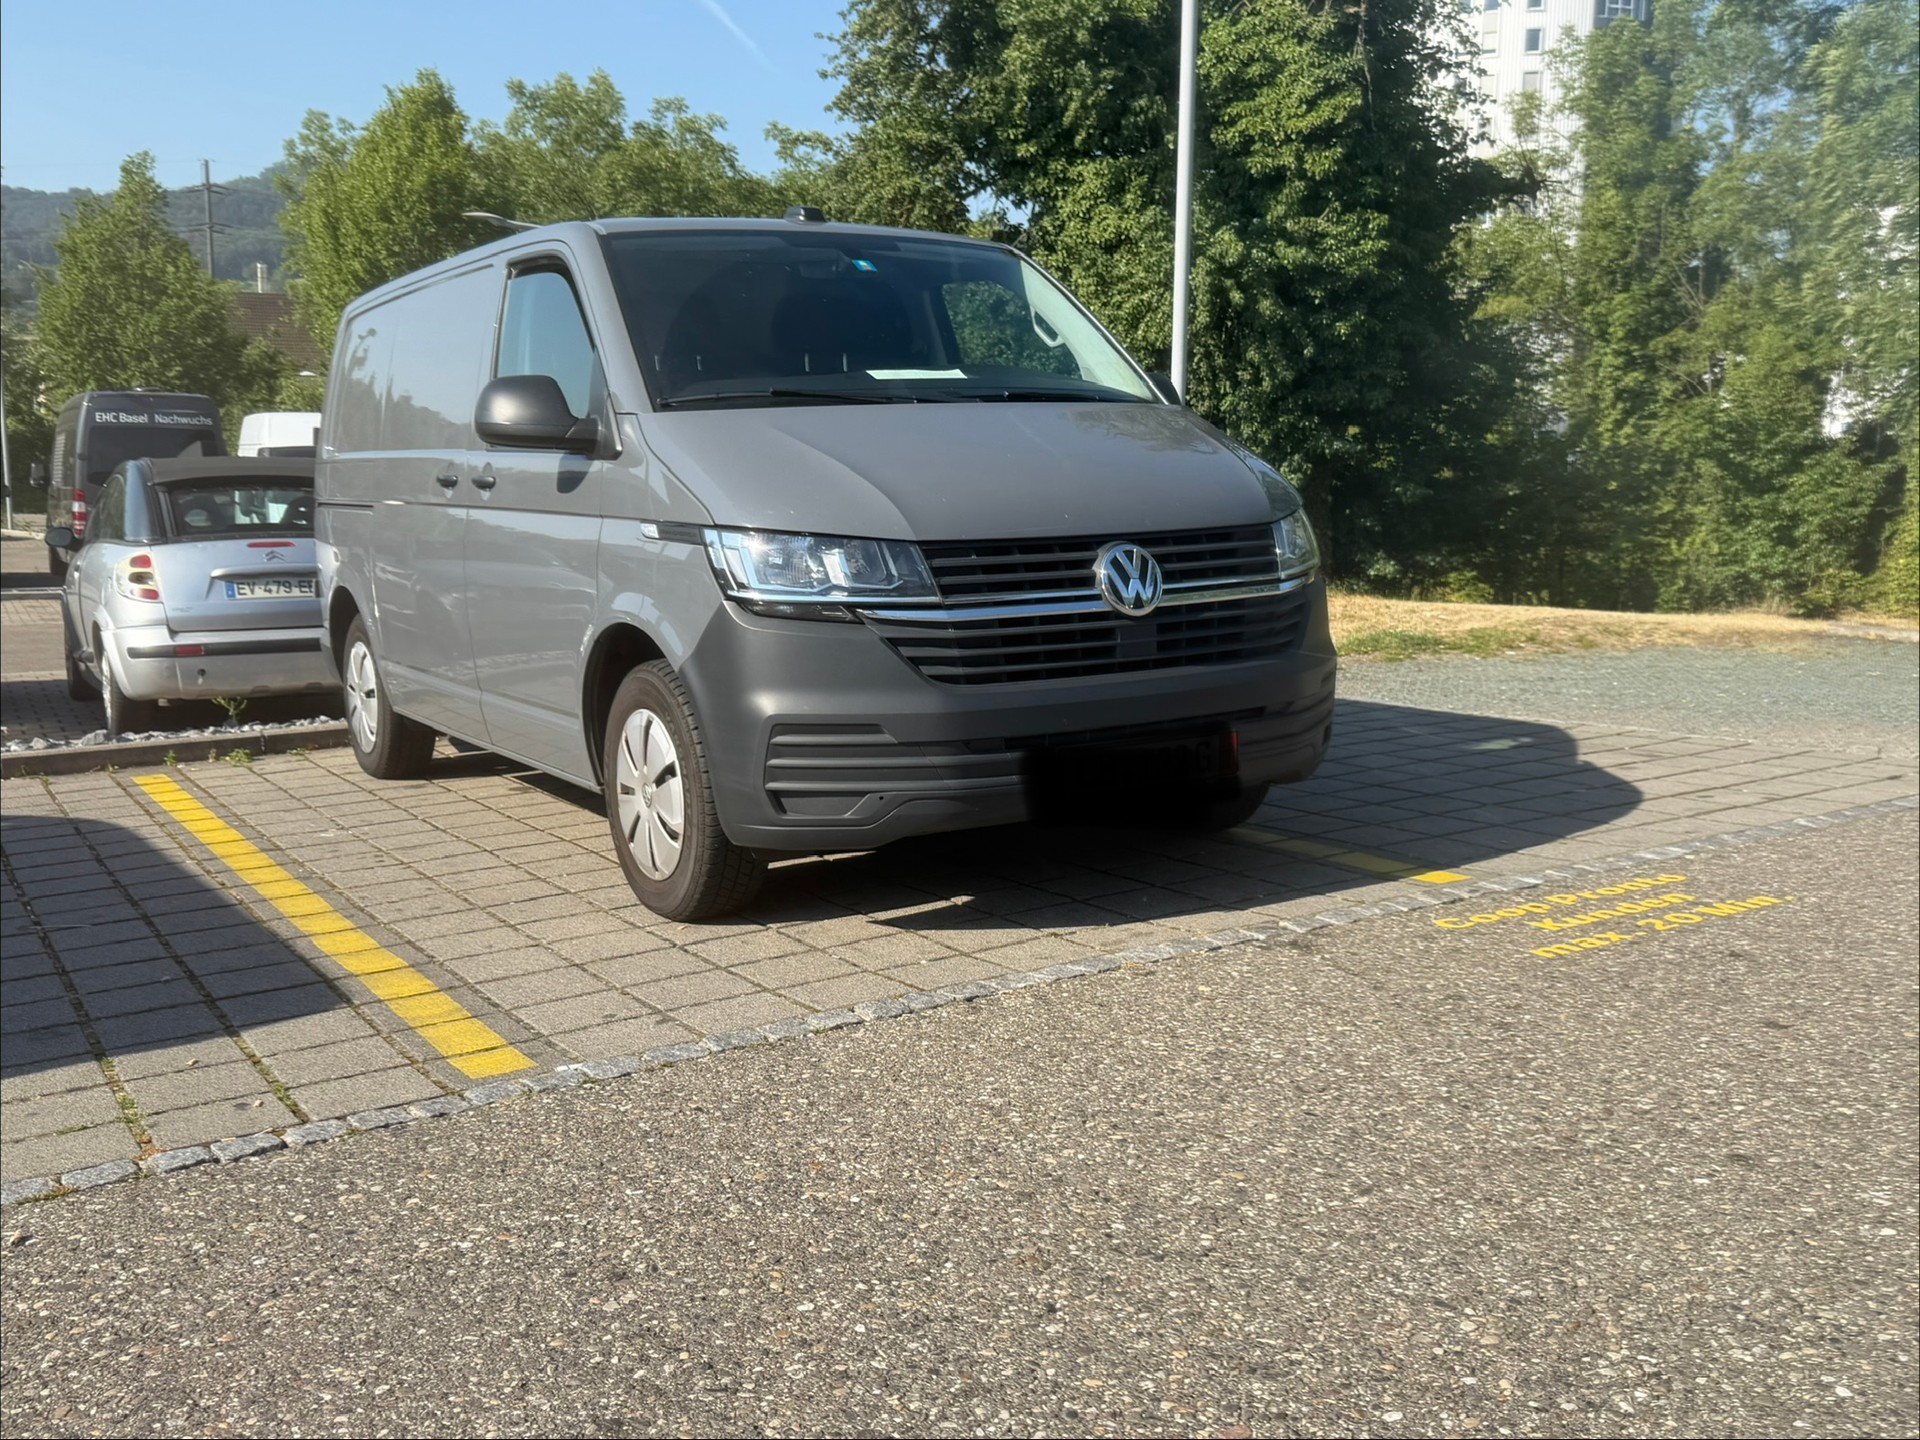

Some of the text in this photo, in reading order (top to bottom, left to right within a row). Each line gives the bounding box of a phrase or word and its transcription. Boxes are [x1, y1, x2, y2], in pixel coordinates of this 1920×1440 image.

[95, 412, 213, 426] EHC Basel Nachwuchs
[1434, 874, 1687, 930] Coop Pronto
[1529, 893, 1696, 932] Kunden
[1636, 912, 1704, 932] 20
